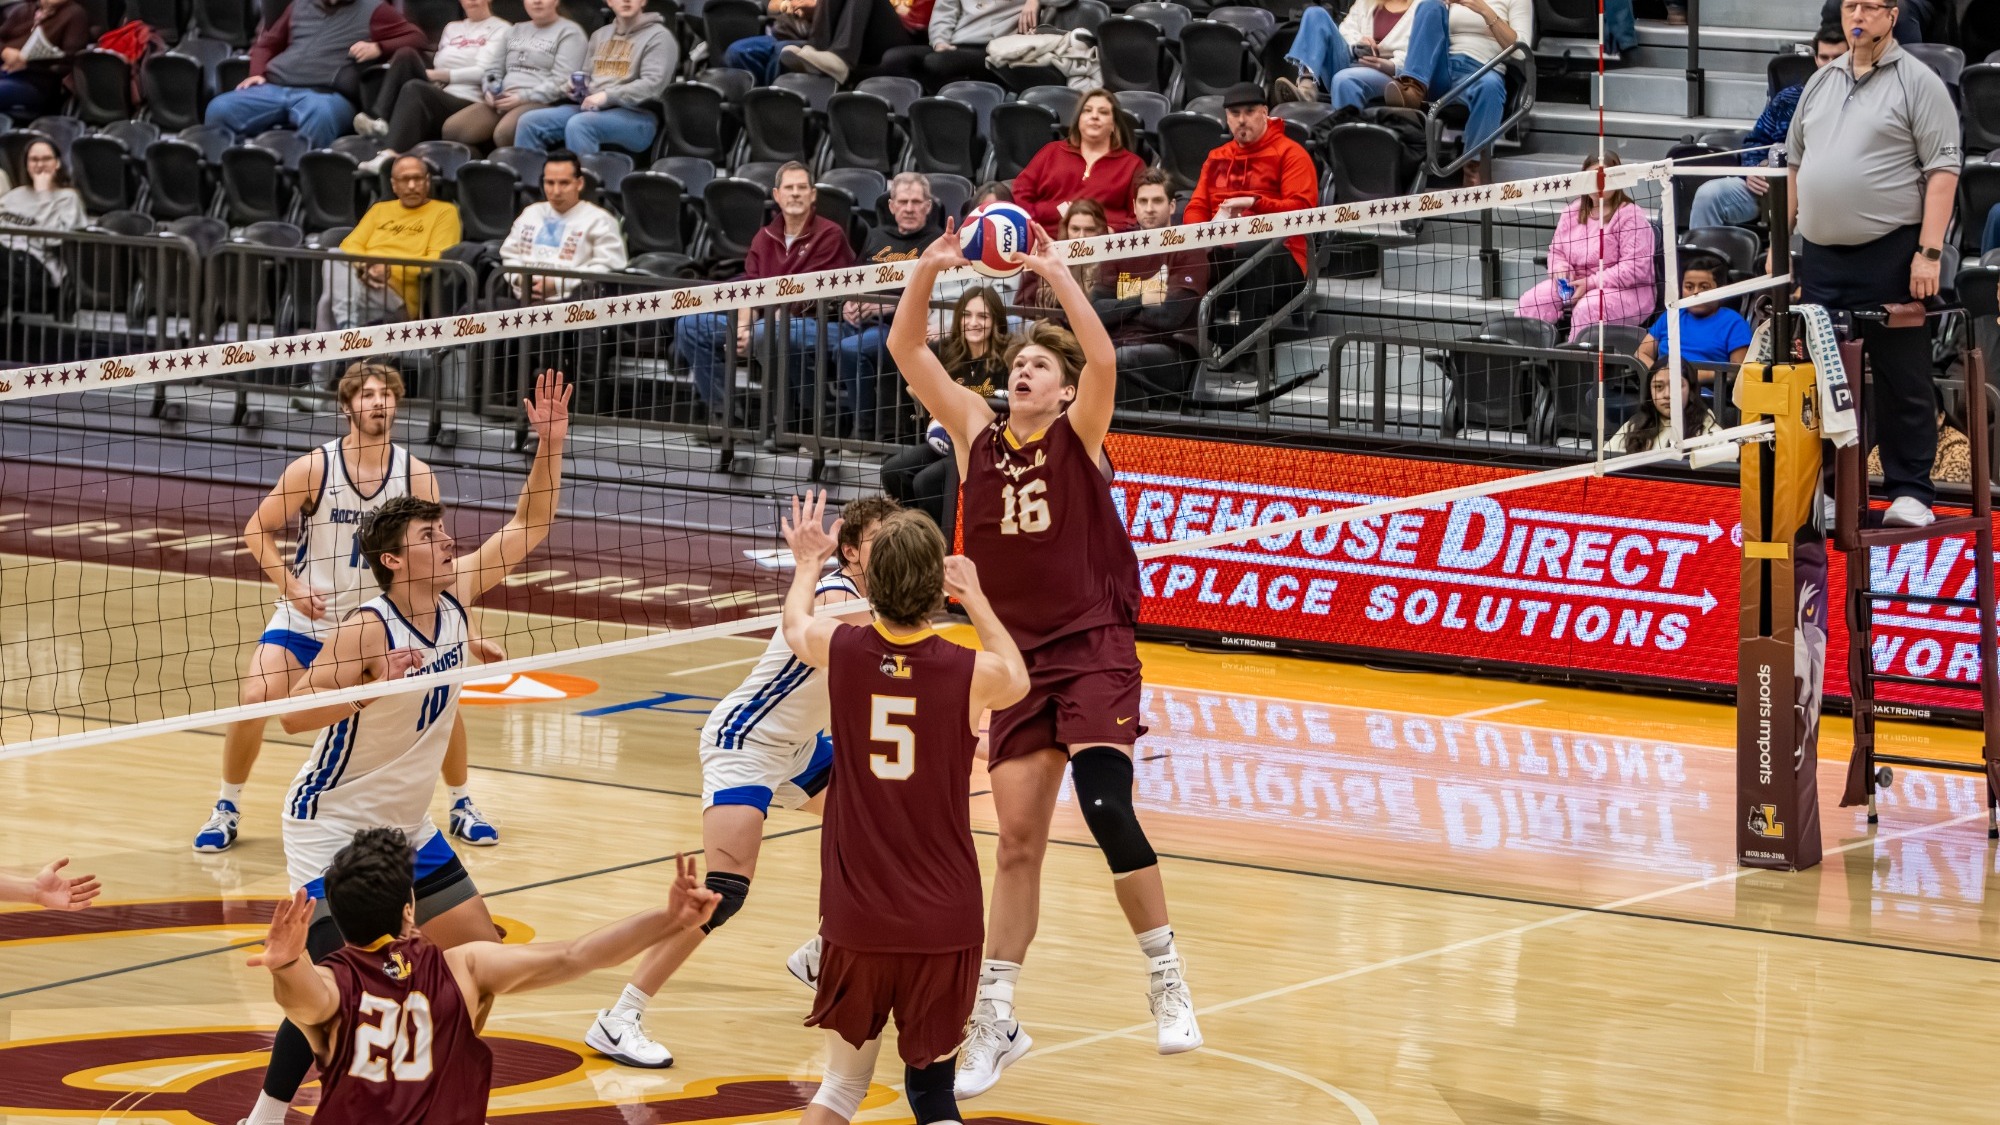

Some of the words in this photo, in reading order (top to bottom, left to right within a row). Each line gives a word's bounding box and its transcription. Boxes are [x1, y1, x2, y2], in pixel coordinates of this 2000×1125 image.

[1003, 224, 1012, 253] NCAA
[1836, 388, 1853, 407] P
[330, 508, 364, 525] ROCK
[1000, 478, 1052, 535] 16
[1221, 636, 1277, 650] DAKTRONICS
[1365, 584, 1690, 651] SOLUTIONS
[416, 684, 450, 733] 10
[1757, 664, 1773, 717] sports
[869, 693, 917, 781] 5
[1757, 719, 1773, 785] imports
[348, 990, 434, 1083] 20
